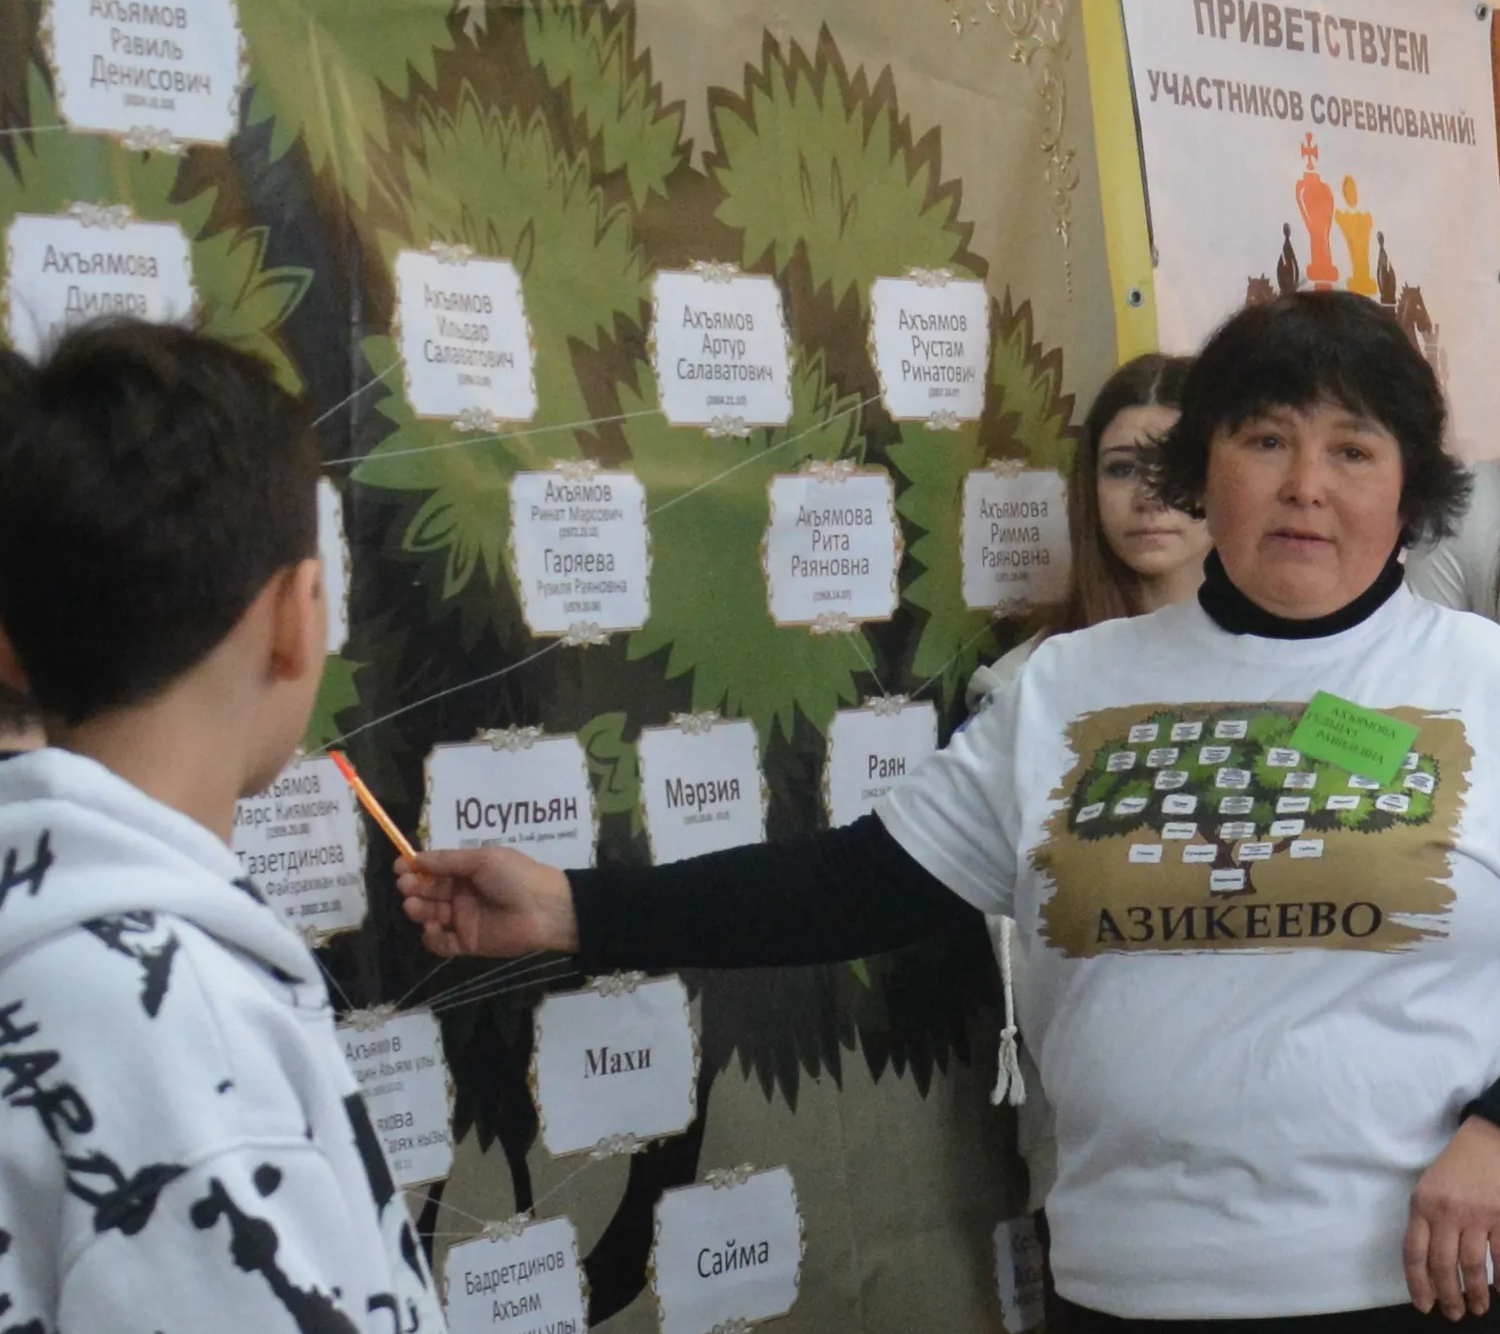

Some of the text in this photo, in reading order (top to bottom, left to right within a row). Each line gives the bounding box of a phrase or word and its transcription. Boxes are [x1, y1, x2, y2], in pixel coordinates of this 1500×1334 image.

[110, 27, 184, 61] Равиль
[90, 54, 212, 95] Денисович
[1147, 69, 1477, 146] УЧАСТНИКОВ СОРЕВНОВАНИЙ!
[42, 243, 159, 278] Ахъямова
[64, 285, 148, 316] Диляра
[423, 282, 493, 314] Ахъямов
[682, 304, 755, 331] Ахъямов
[899, 308, 968, 332] Ахъямов
[702, 332, 746, 360] Артур
[911, 335, 965, 360] Рустам
[677, 358, 774, 382] Салаватович
[901, 359, 975, 383] Ринатович
[544, 480, 612, 503] Ахъямов
[980, 498, 1049, 519] Ахъямова
[812, 529, 850, 552] Рита
[990, 522, 1040, 544] Римма
[544, 549, 616, 577] Гаряева
[791, 554, 870, 578] Раяновна
[982, 547, 1051, 568] Раяновна
[868, 754, 906, 779] Раян
[665, 777, 740, 812] Мәрзия
[455, 796, 578, 833] Юсупьян
[1096, 901, 1383, 943] АЗИКЕЕВО
[583, 1046, 652, 1078] Махи
[697, 1239, 770, 1278] Сайма
[465, 1251, 565, 1296] Бадретдинов
[492, 1293, 542, 1323] Ахъям
